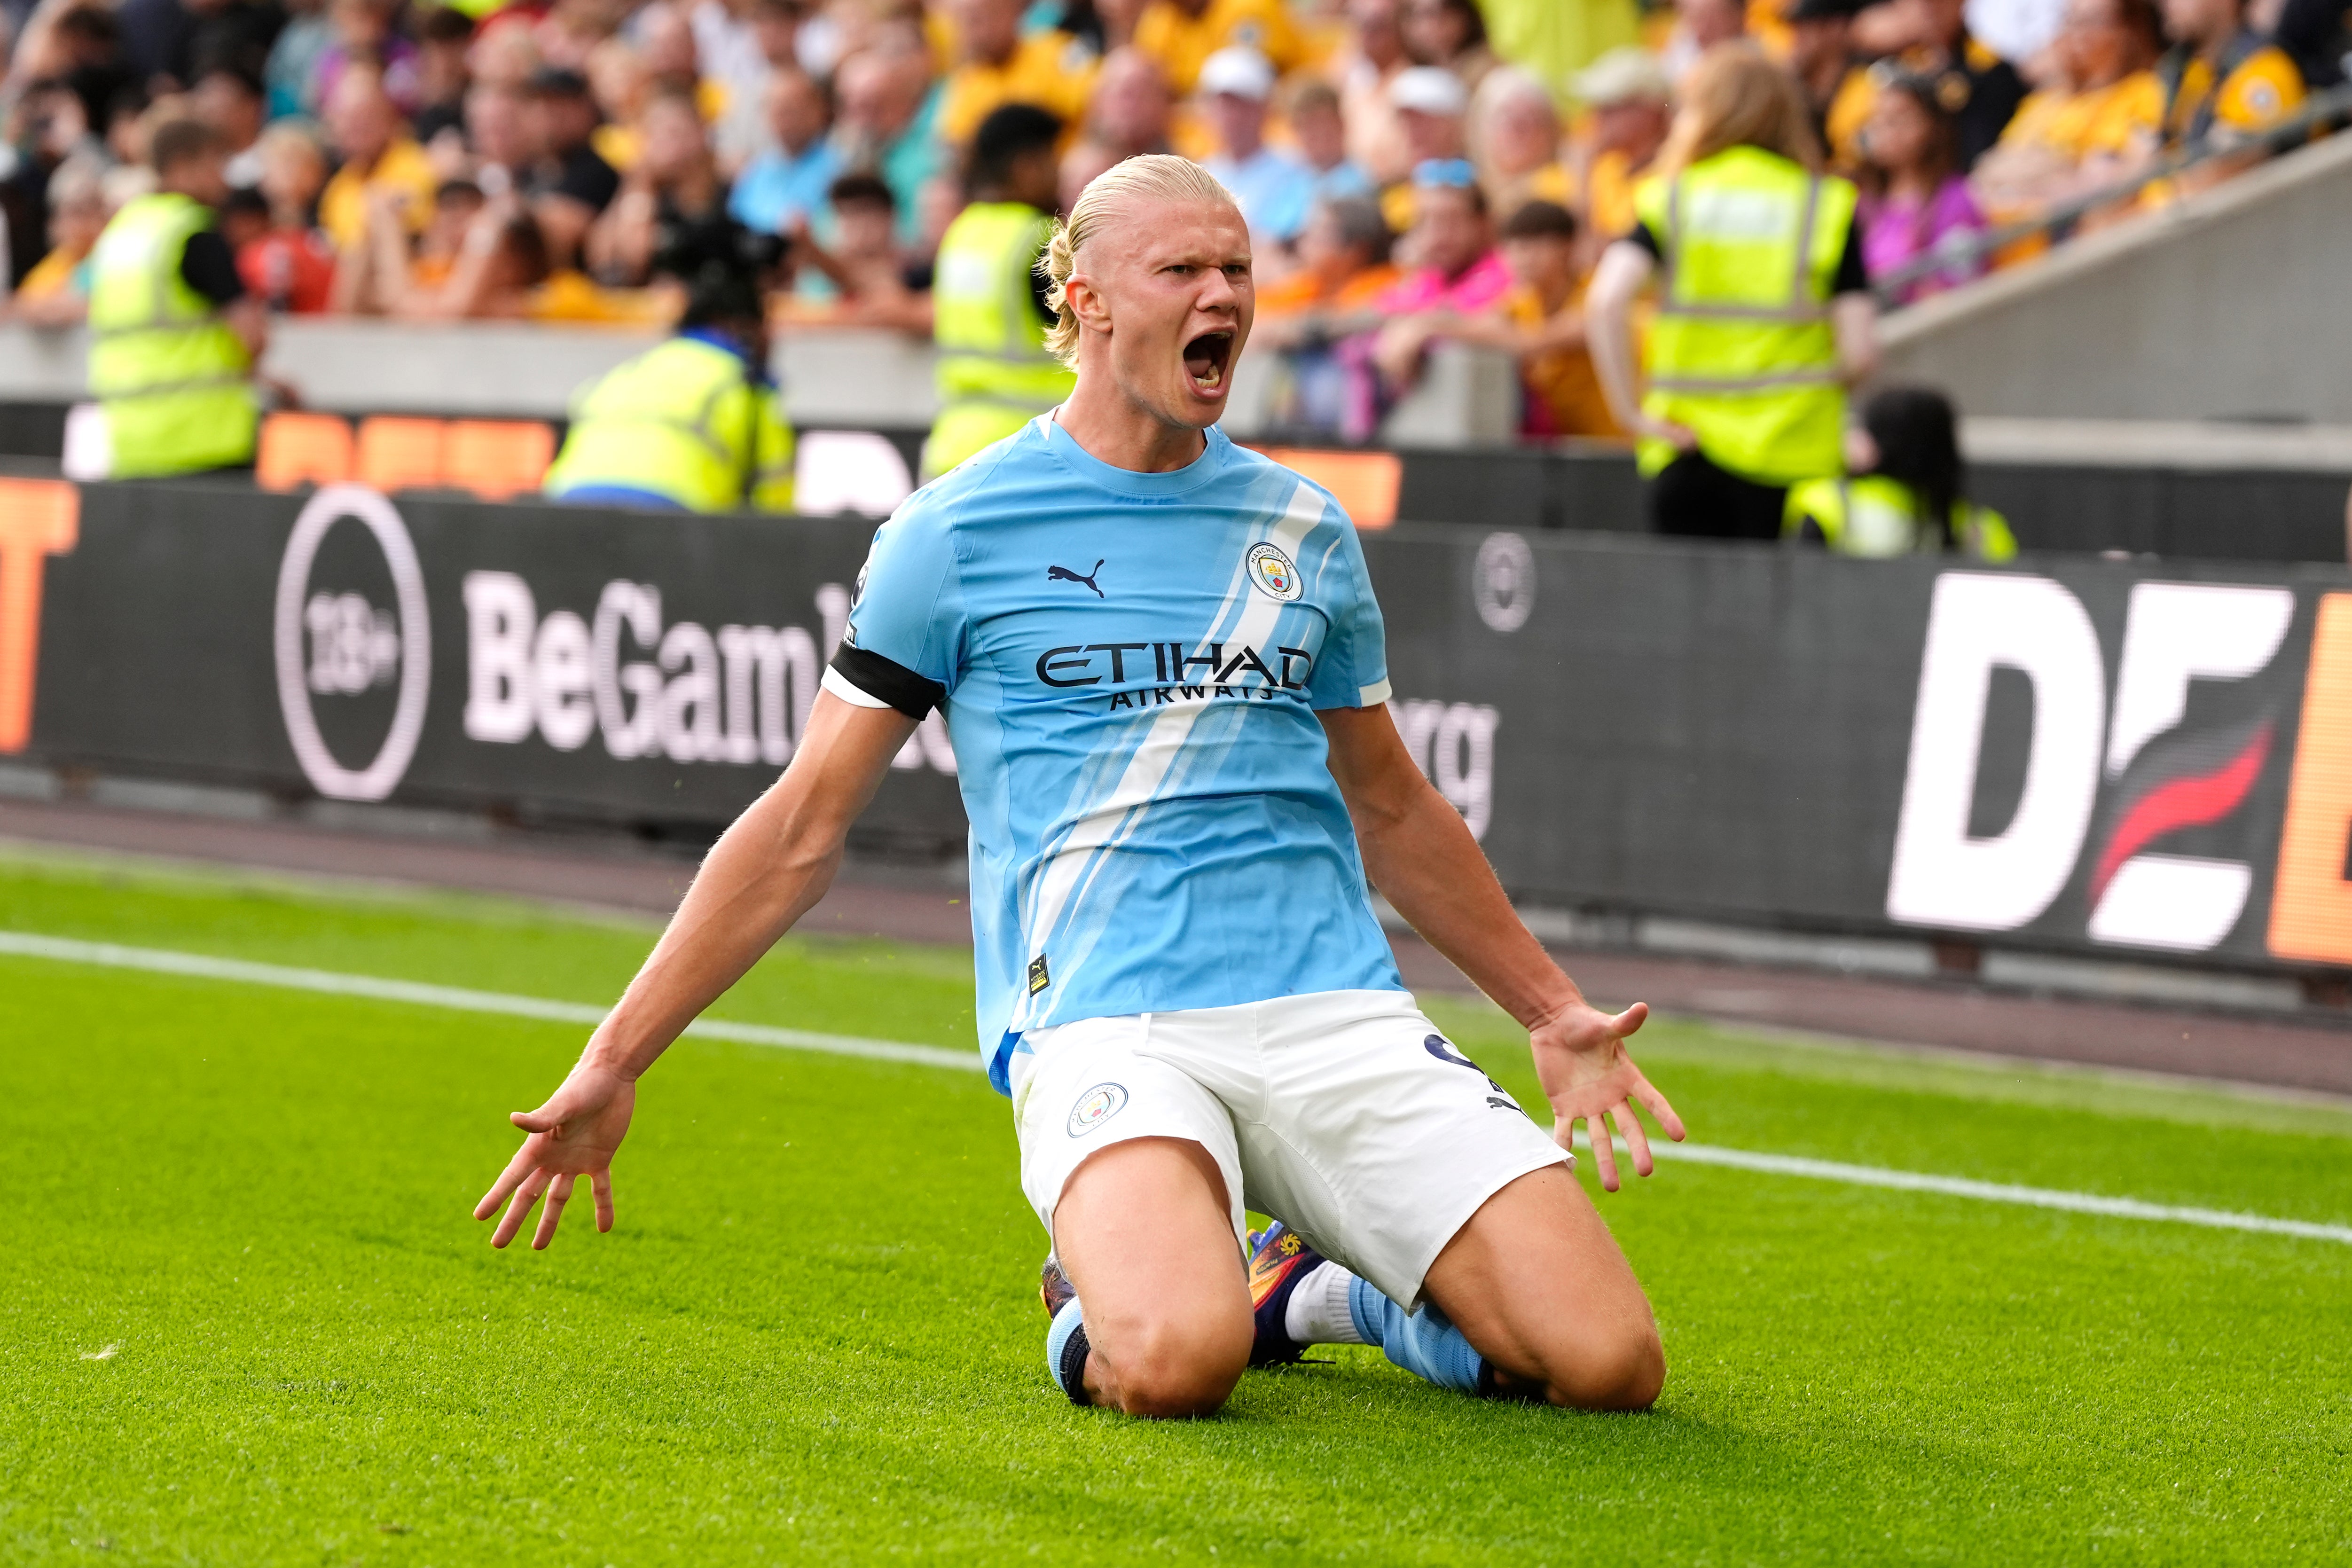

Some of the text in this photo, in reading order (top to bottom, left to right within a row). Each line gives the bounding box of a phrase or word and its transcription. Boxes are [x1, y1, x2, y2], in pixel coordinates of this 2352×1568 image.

[1251, 547, 1292, 570] MANCHESTER
[1036, 643, 1312, 690] ETIHAD
[1110, 686, 1273, 711] AIRWAYS
[1389, 698, 1500, 842] rg
